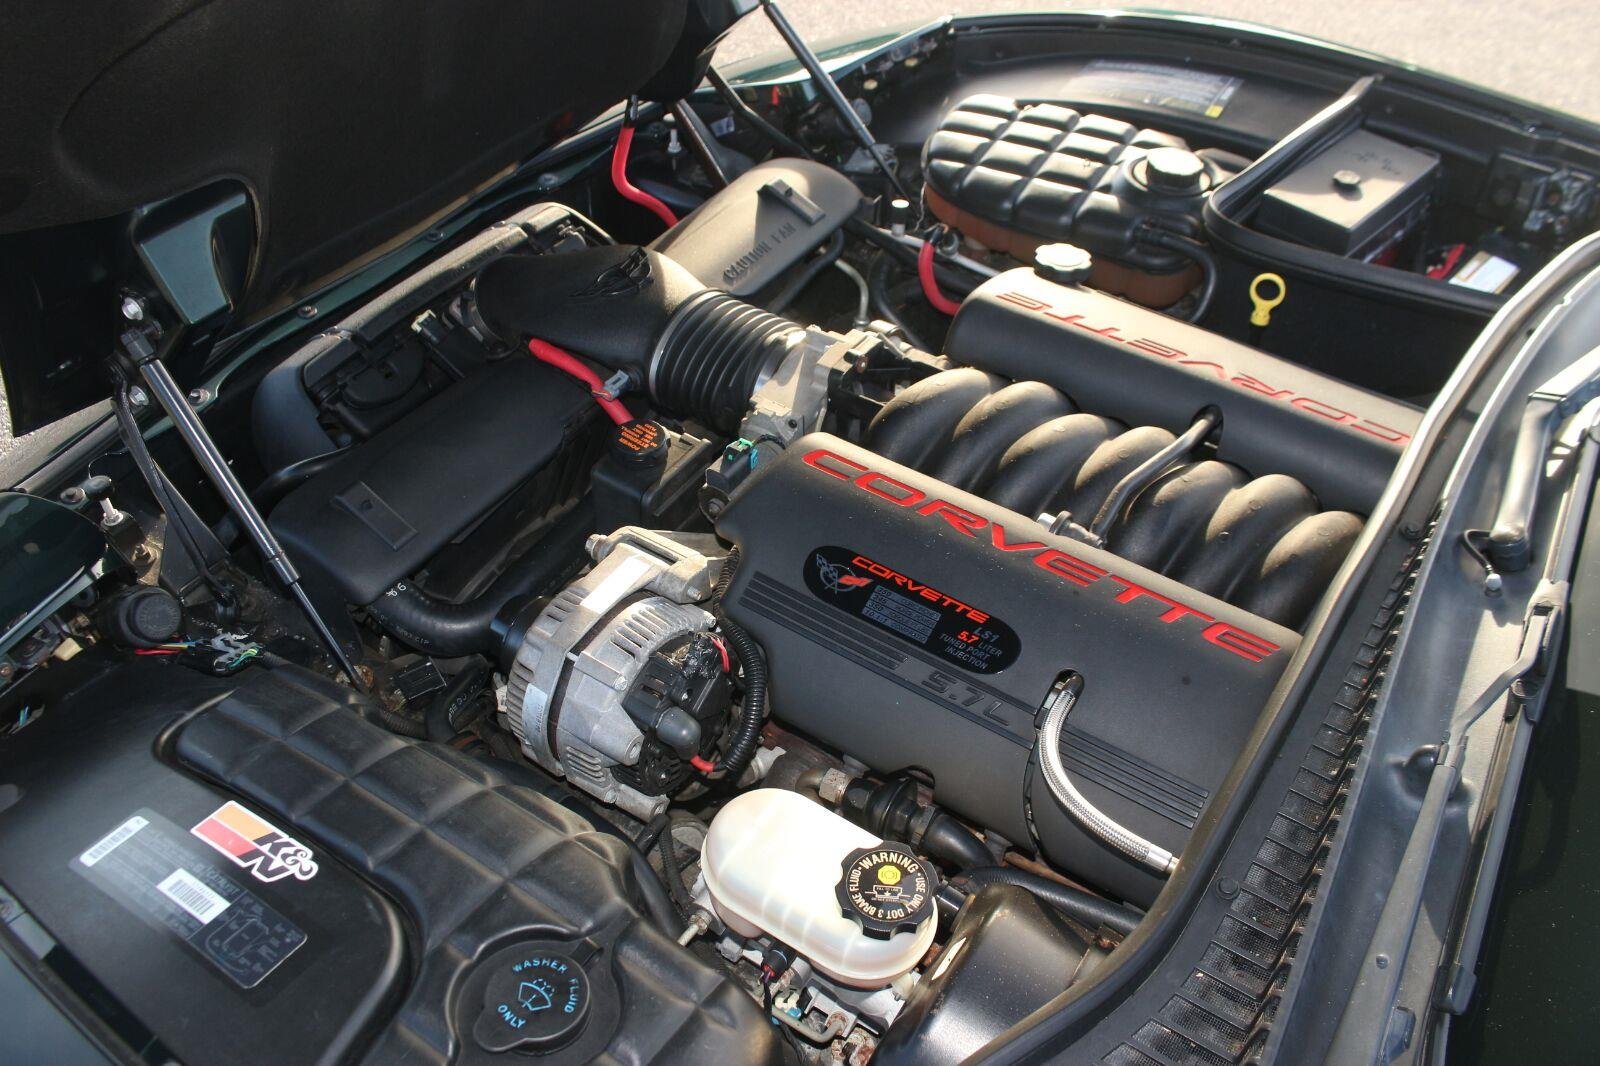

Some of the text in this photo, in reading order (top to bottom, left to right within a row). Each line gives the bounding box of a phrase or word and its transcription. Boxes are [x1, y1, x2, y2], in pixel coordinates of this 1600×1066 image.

[723, 222, 797, 286] CAUTION FAN
[997, 291, 1410, 445] CORVETTE
[802, 448, 1280, 662] CORVETTE
[852, 556, 990, 624] CORVETTE
[940, 634, 991, 660] TUNED PORT
[945, 648, 988, 670] INJECTION
[957, 630, 1003, 656] 5.7 LITER
[973, 627, 1000, 644] LS1
[921, 670, 1009, 727] 5.7L
[236, 831, 315, 879] K&N
[860, 851, 919, 874] WARNING
[849, 868, 926, 919] USE ONLY DOT 3 BRAKE FLUID
[497, 957, 579, 1029] WASHER FLUID ONLY
